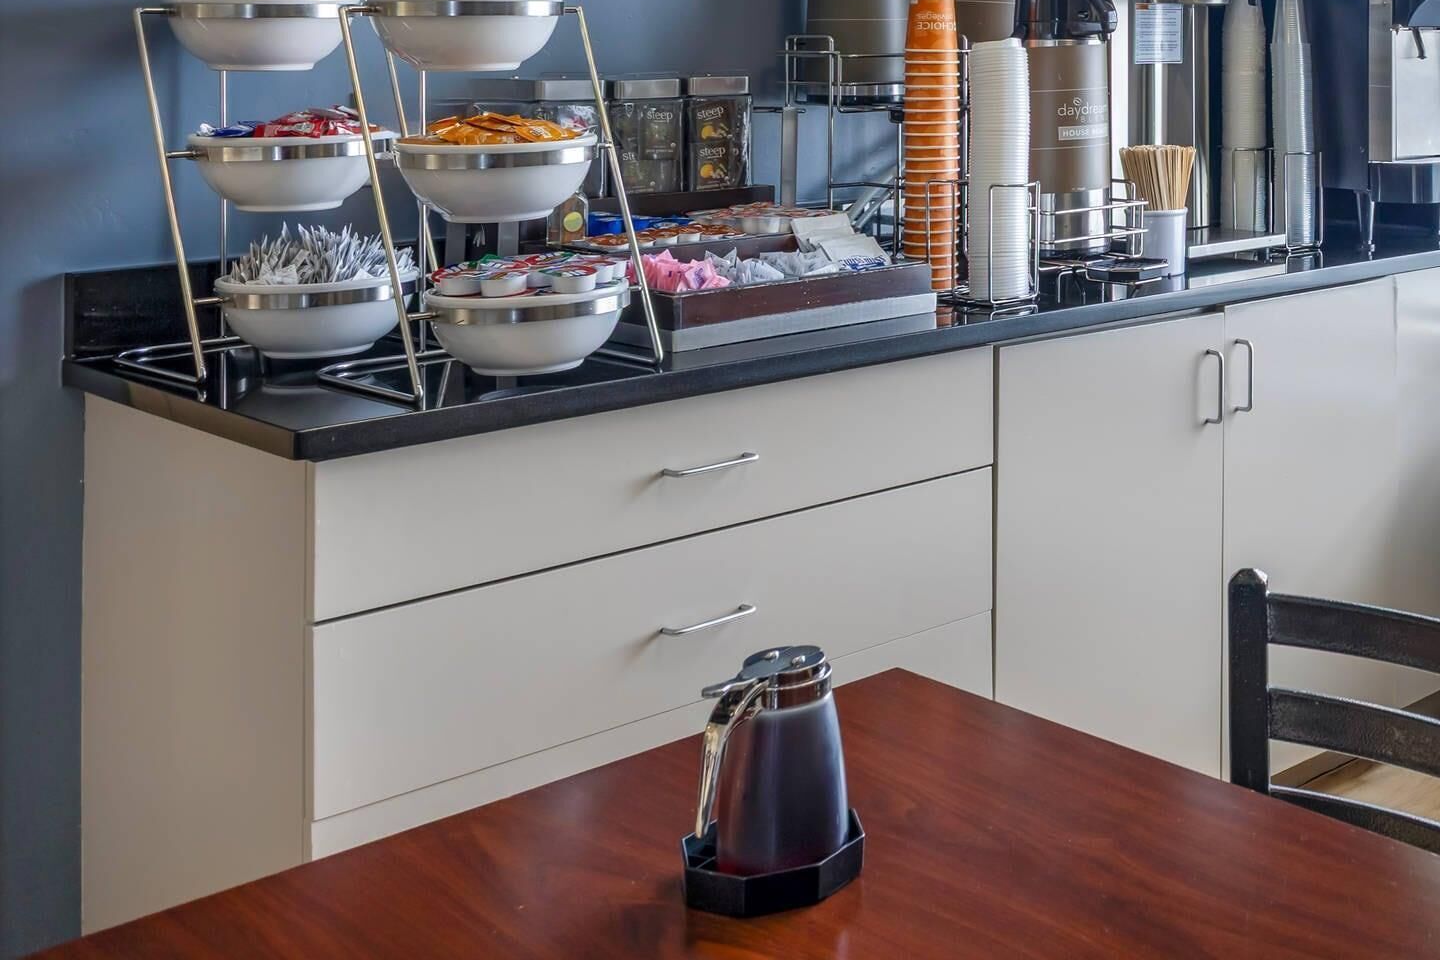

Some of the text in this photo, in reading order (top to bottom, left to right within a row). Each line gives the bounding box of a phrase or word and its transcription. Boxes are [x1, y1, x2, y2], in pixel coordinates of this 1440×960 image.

[917, 21, 954, 31] CHOICE
[646, 110, 674, 123] steep
[697, 106, 724, 120] steep
[699, 146, 726, 158] steep
